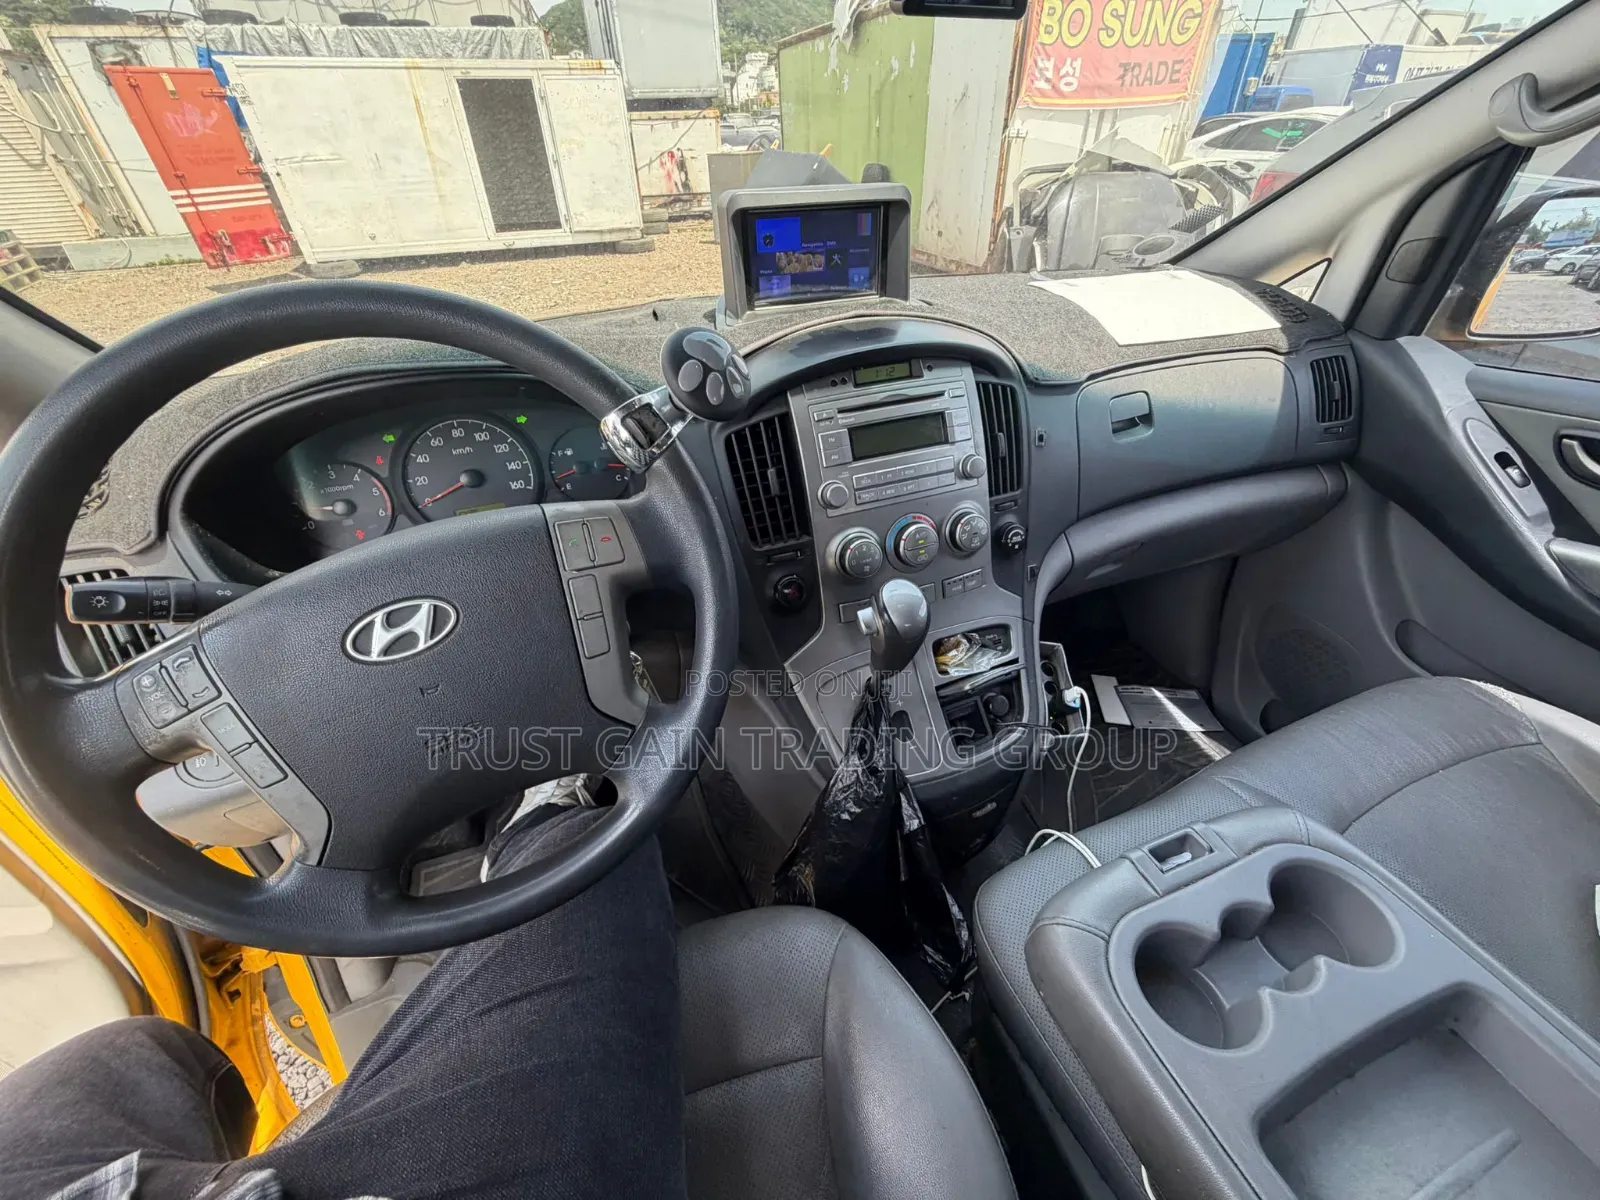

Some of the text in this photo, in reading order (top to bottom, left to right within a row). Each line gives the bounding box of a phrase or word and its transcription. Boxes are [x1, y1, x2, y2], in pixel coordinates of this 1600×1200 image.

[1037, 0, 1203, 48] BO SUNG
[1032, 57, 1082, 92] 보성
[1118, 59, 1185, 88] TRADE
[452, 428, 465, 438] 80
[473, 431, 490, 442] 100
[430, 437, 444, 447] 60
[452, 447, 473, 456] km/h
[493, 443, 510, 453] 120
[416, 454, 430, 463] 40
[506, 461, 522, 471] 140
[328, 470, 336, 480] 3
[353, 474, 360, 482] 4
[415, 476, 428, 486] 20
[509, 480, 525, 490] 160
[372, 488, 380, 496] 5
[378, 508, 386, 517] 6
[307, 520, 315, 530] 0
